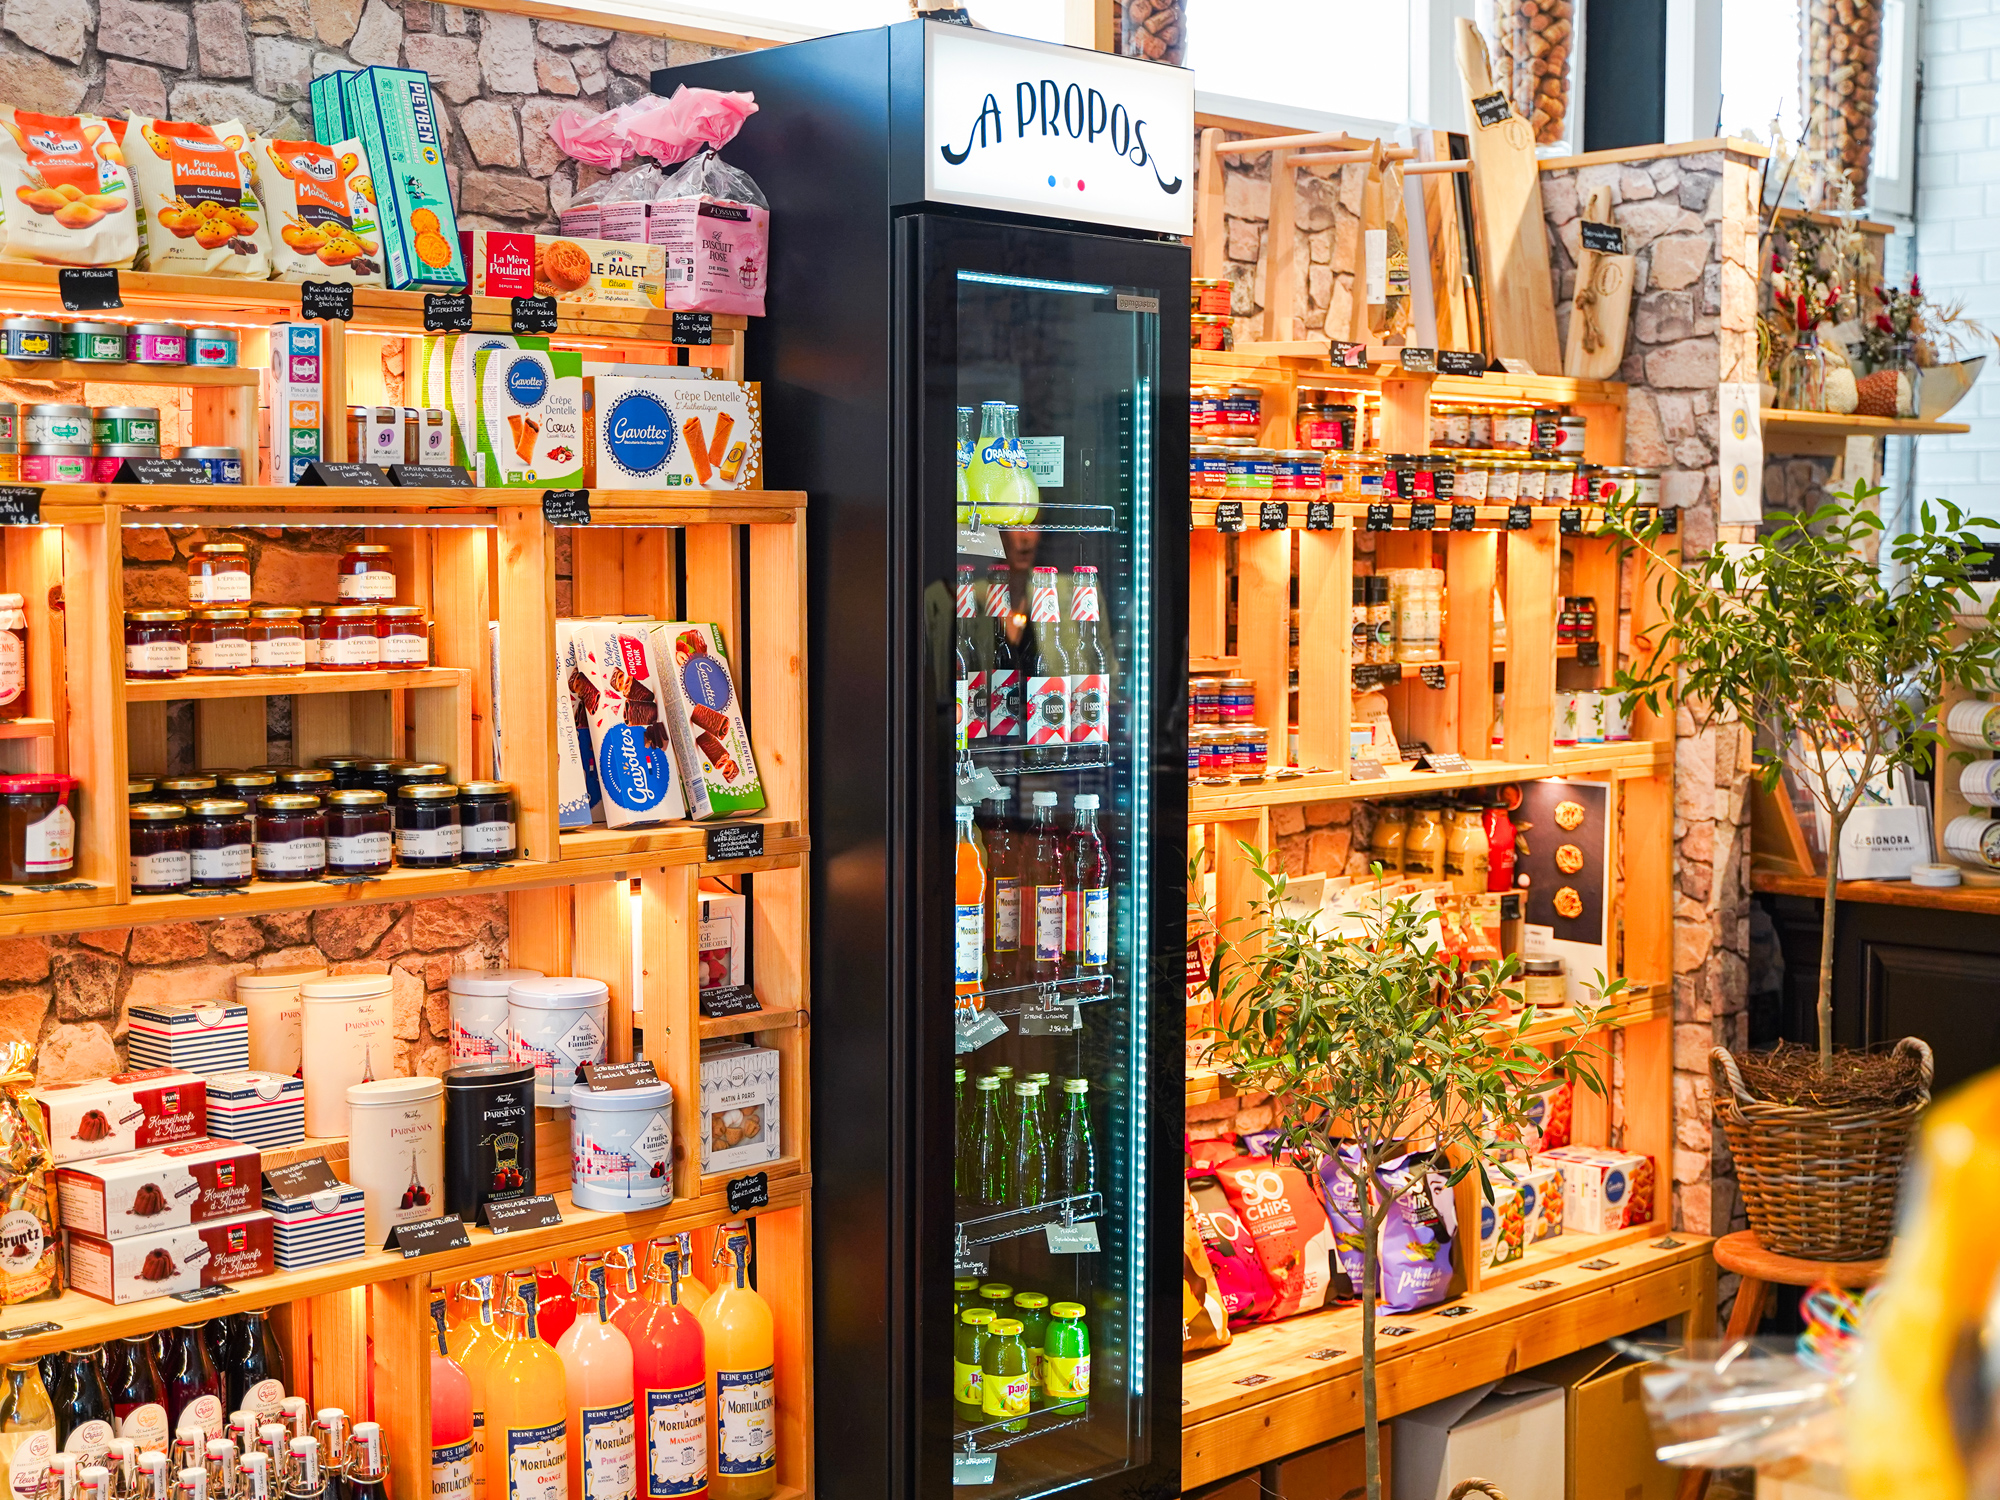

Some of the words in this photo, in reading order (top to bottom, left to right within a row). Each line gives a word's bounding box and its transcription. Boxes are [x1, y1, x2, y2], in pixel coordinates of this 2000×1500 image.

[408, 82, 435, 143] PLEYBEN
[1016, 79, 1182, 195] PROPOS
[39, 141, 78, 151] Michel
[193, 159, 217, 169] Petites
[176, 163, 236, 179] Madeleines
[197, 187, 222, 195] Chocolat
[710, 207, 743, 218] FOSSIER
[702, 240, 734, 253] BISCUIT
[493, 253, 505, 263] La
[506, 252, 529, 265] Mère
[709, 250, 728, 262] ROSE
[489, 262, 531, 276] Poulard
[590, 263, 604, 275] LE
[608, 264, 647, 278] PALET
[608, 279, 626, 288] Citron
[511, 372, 544, 386] Gavottes
[549, 395, 572, 405] Crêpe
[674, 389, 701, 402] Crêpe
[704, 390, 741, 403] Dentelle
[545, 405, 577, 415] Dentelle
[546, 418, 577, 434] Cœur
[614, 417, 669, 444] Gavottes
[380, 433, 391, 442] 91
[430, 435, 440, 444] 91
[712, 625, 723, 652] NOUVEAU
[625, 640, 637, 675] CHOCOLAT
[631, 649, 643, 672] NOIR
[695, 661, 716, 707] Gavottes
[567, 723, 577, 765] Dentelle
[733, 716, 742, 739] CRÊPE
[740, 739, 754, 775] DENTELLE
[627, 728, 655, 804] Gavottes
[1865, 835, 1910, 845] SIGNORA
[345, 1018, 385, 1032] PARISIENNES
[567, 1039, 600, 1048] Fantaisie
[570, 1033, 597, 1041] Truffes
[162, 1093, 180, 1102] Bruntz
[720, 1094, 736, 1103] MATIN
[742, 1091, 756, 1099] PARIS
[148, 1112, 195, 1128] Kougelhopfs
[483, 1106, 526, 1121] PARISIENNES
[154, 1123, 191, 1137] d'Alsace
[390, 1123, 433, 1137] PARISIENNES
[646, 1134, 668, 1143] Truffes
[642, 1141, 669, 1150] Fantaisie
[216, 1166, 235, 1175] Bruntz
[204, 1186, 250, 1202] Kougelhopfs
[1234, 1171, 1284, 1205] SO
[210, 1197, 246, 1210] d'Alsace
[1263, 1220, 1297, 1232] CHAUDRON
[228, 1232, 246, 1240] Bruntz
[213, 1248, 262, 1266] Kougelhopfs
[221, 1261, 258, 1275] d'Alsace
[720, 1373, 741, 1381] REINE
[746, 1418, 765, 1428] CITRON
[512, 1431, 534, 1439] REINE
[669, 1432, 702, 1445] MANDARINE
[600, 1455, 618, 1466] PINK
[537, 1473, 561, 1485] ORANGE
